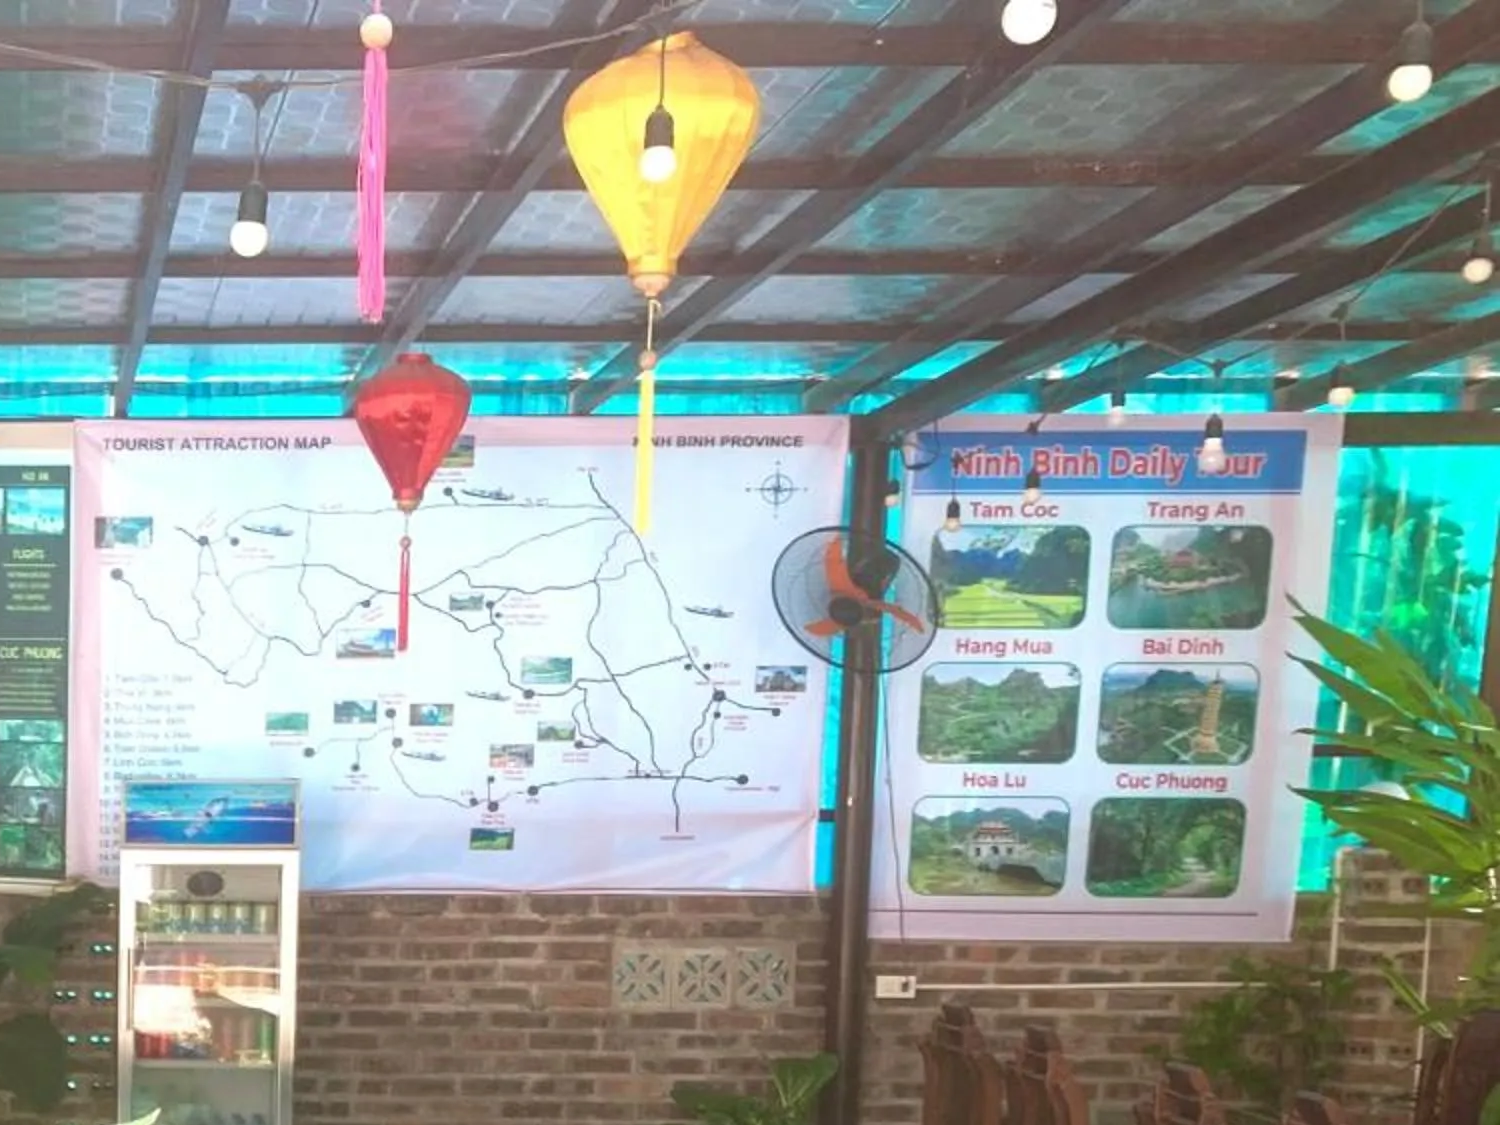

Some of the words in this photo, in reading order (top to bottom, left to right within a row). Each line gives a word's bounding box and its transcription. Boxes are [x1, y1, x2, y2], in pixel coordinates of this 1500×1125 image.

[103, 437, 174, 451] TOURIST
[180, 437, 289, 450] ATTRACTION
[294, 436, 332, 449] MAP
[676, 435, 715, 447] BINH
[720, 435, 804, 447] PROVINCE
[952, 447, 1024, 478] Ninh
[1030, 447, 1102, 478] Binh
[1108, 448, 1188, 486] Daily
[970, 502, 1013, 518] Tam
[1020, 502, 1059, 518] Coc
[1147, 502, 1210, 520] Trang
[1213, 502, 1245, 518] An
[956, 638, 1006, 657] Hang
[1013, 639, 1052, 655] Mua
[1143, 638, 1173, 655] Bai
[1178, 638, 1224, 655] Dinh
[963, 773, 998, 788] Hoa
[1003, 773, 1027, 788] Lu
[1116, 773, 1151, 789] Cuc
[1156, 773, 1228, 792] Phuong
